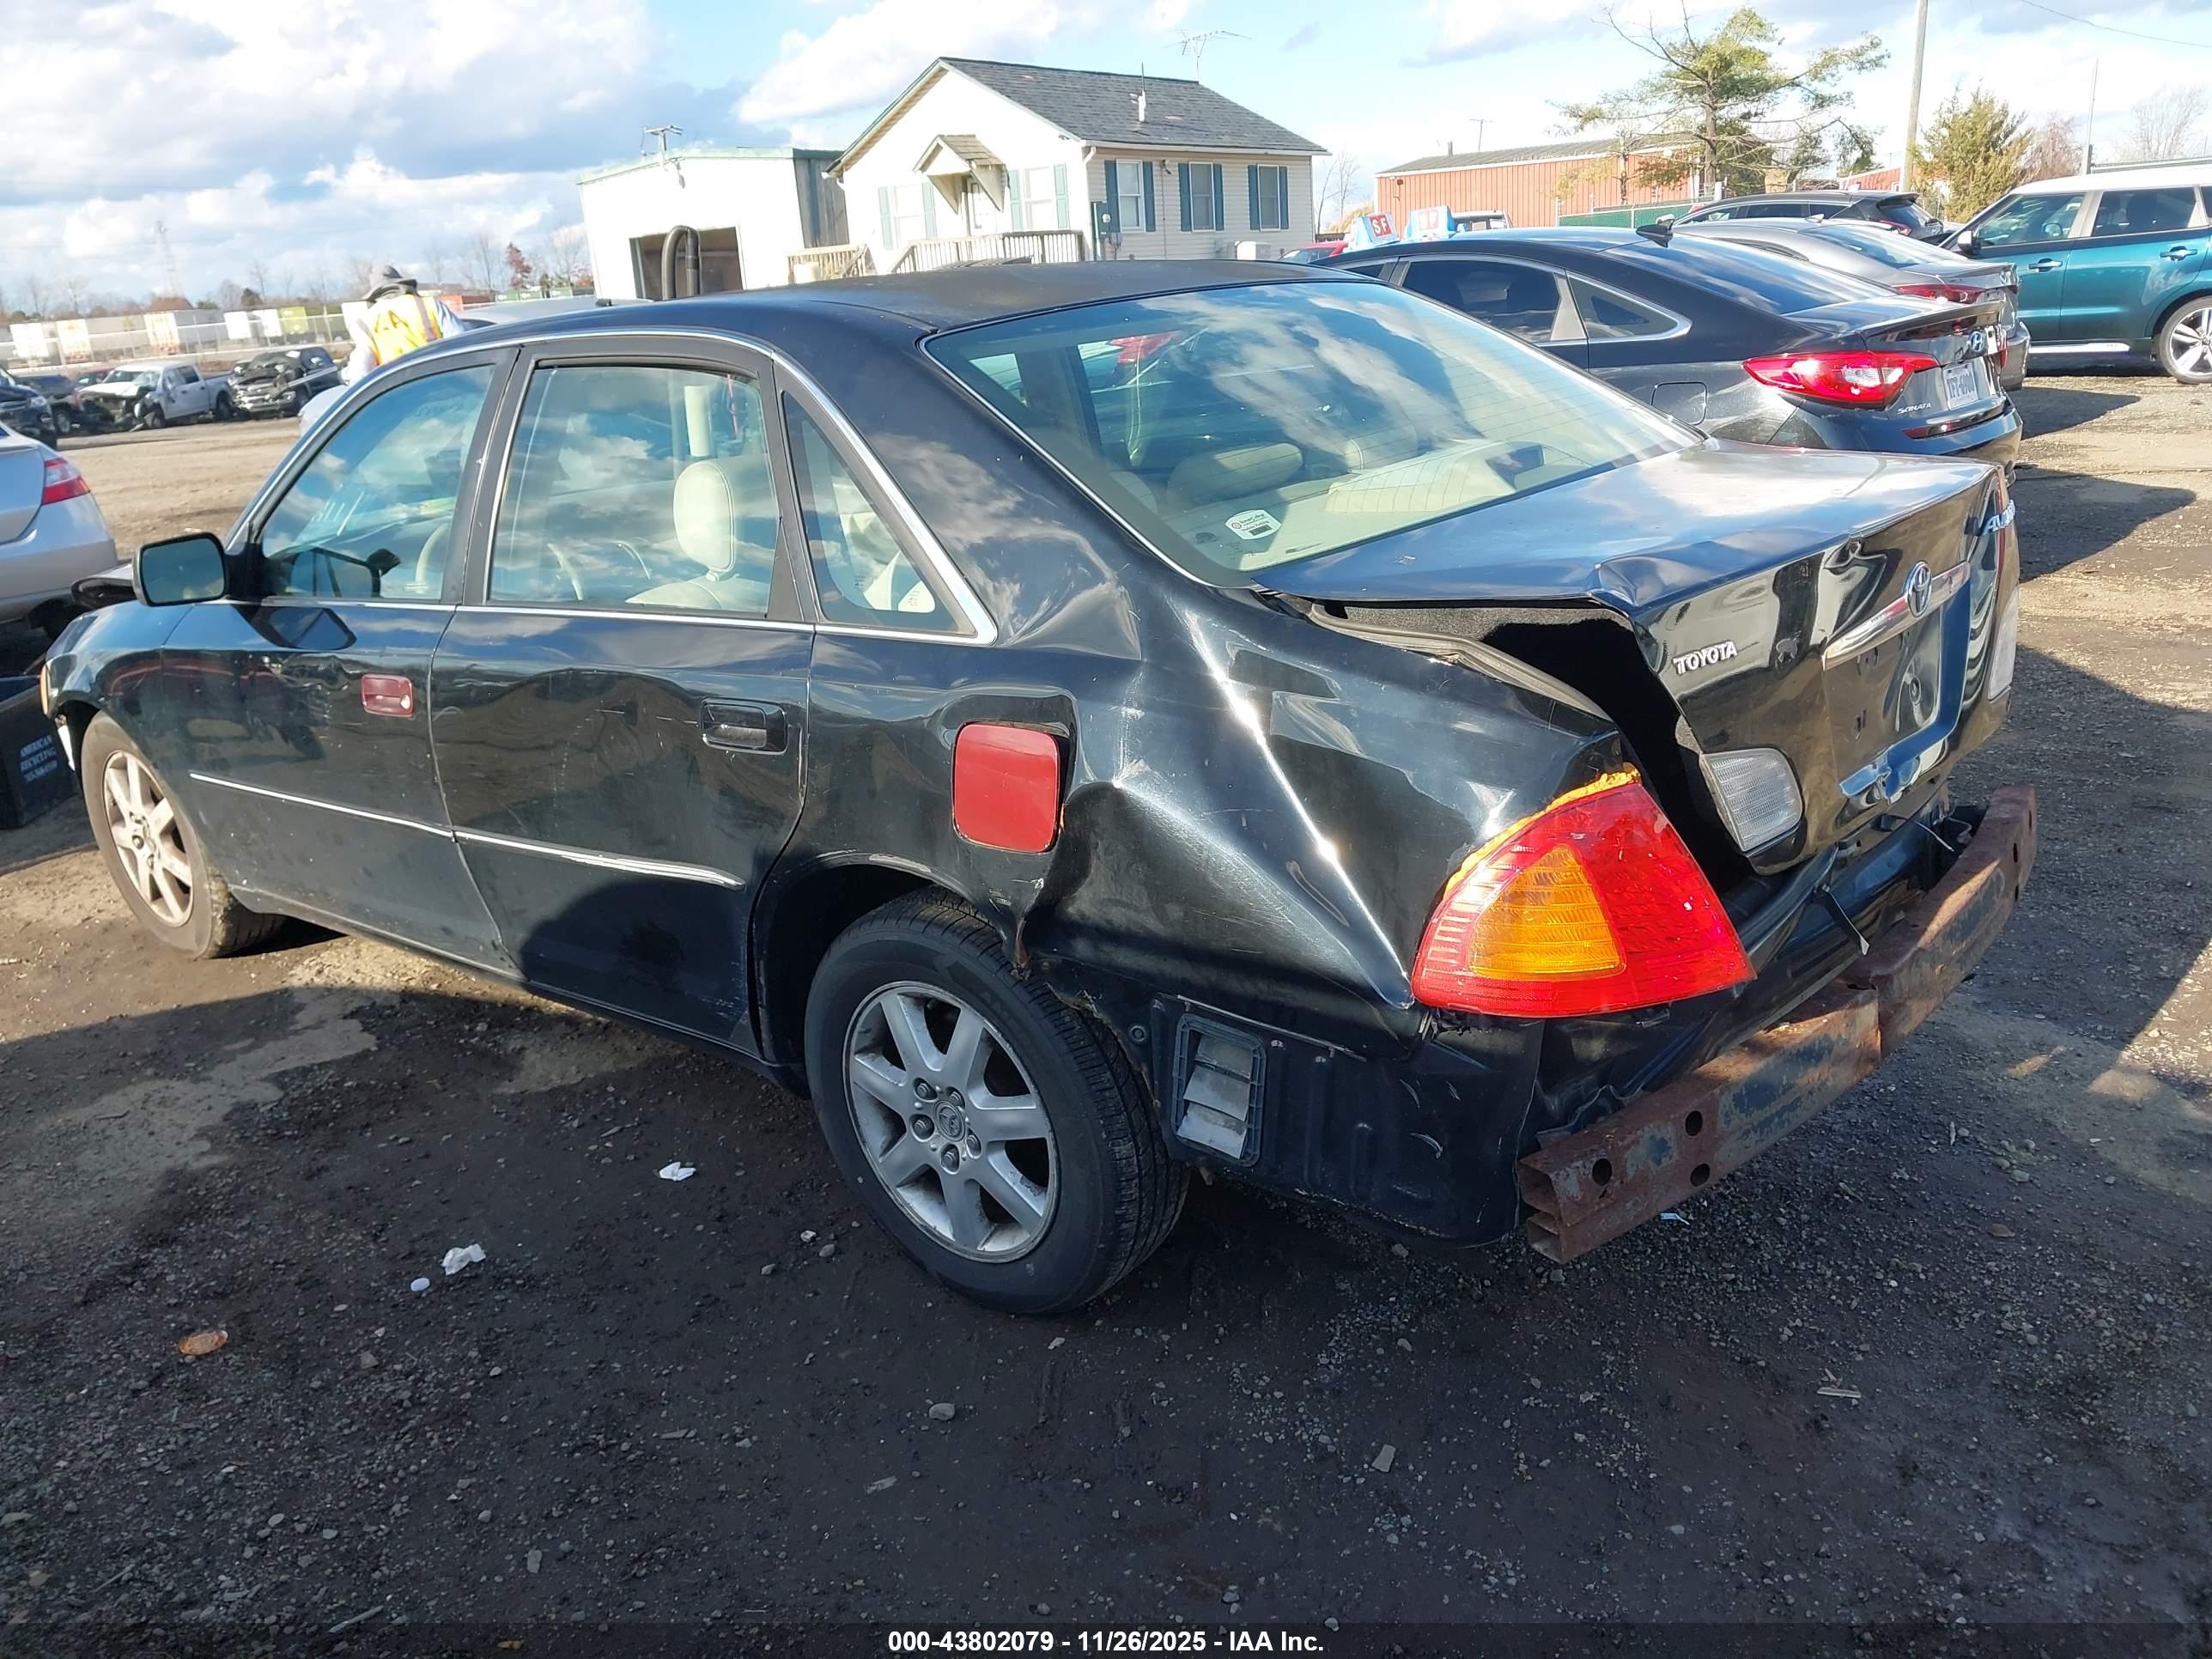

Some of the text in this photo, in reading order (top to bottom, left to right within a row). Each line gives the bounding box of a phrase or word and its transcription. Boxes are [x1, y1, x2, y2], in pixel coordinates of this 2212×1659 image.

[1372, 217, 1389, 234] SF
[1897, 402, 1931, 414] SONATA
[1673, 641, 1738, 675] TOYOTA
